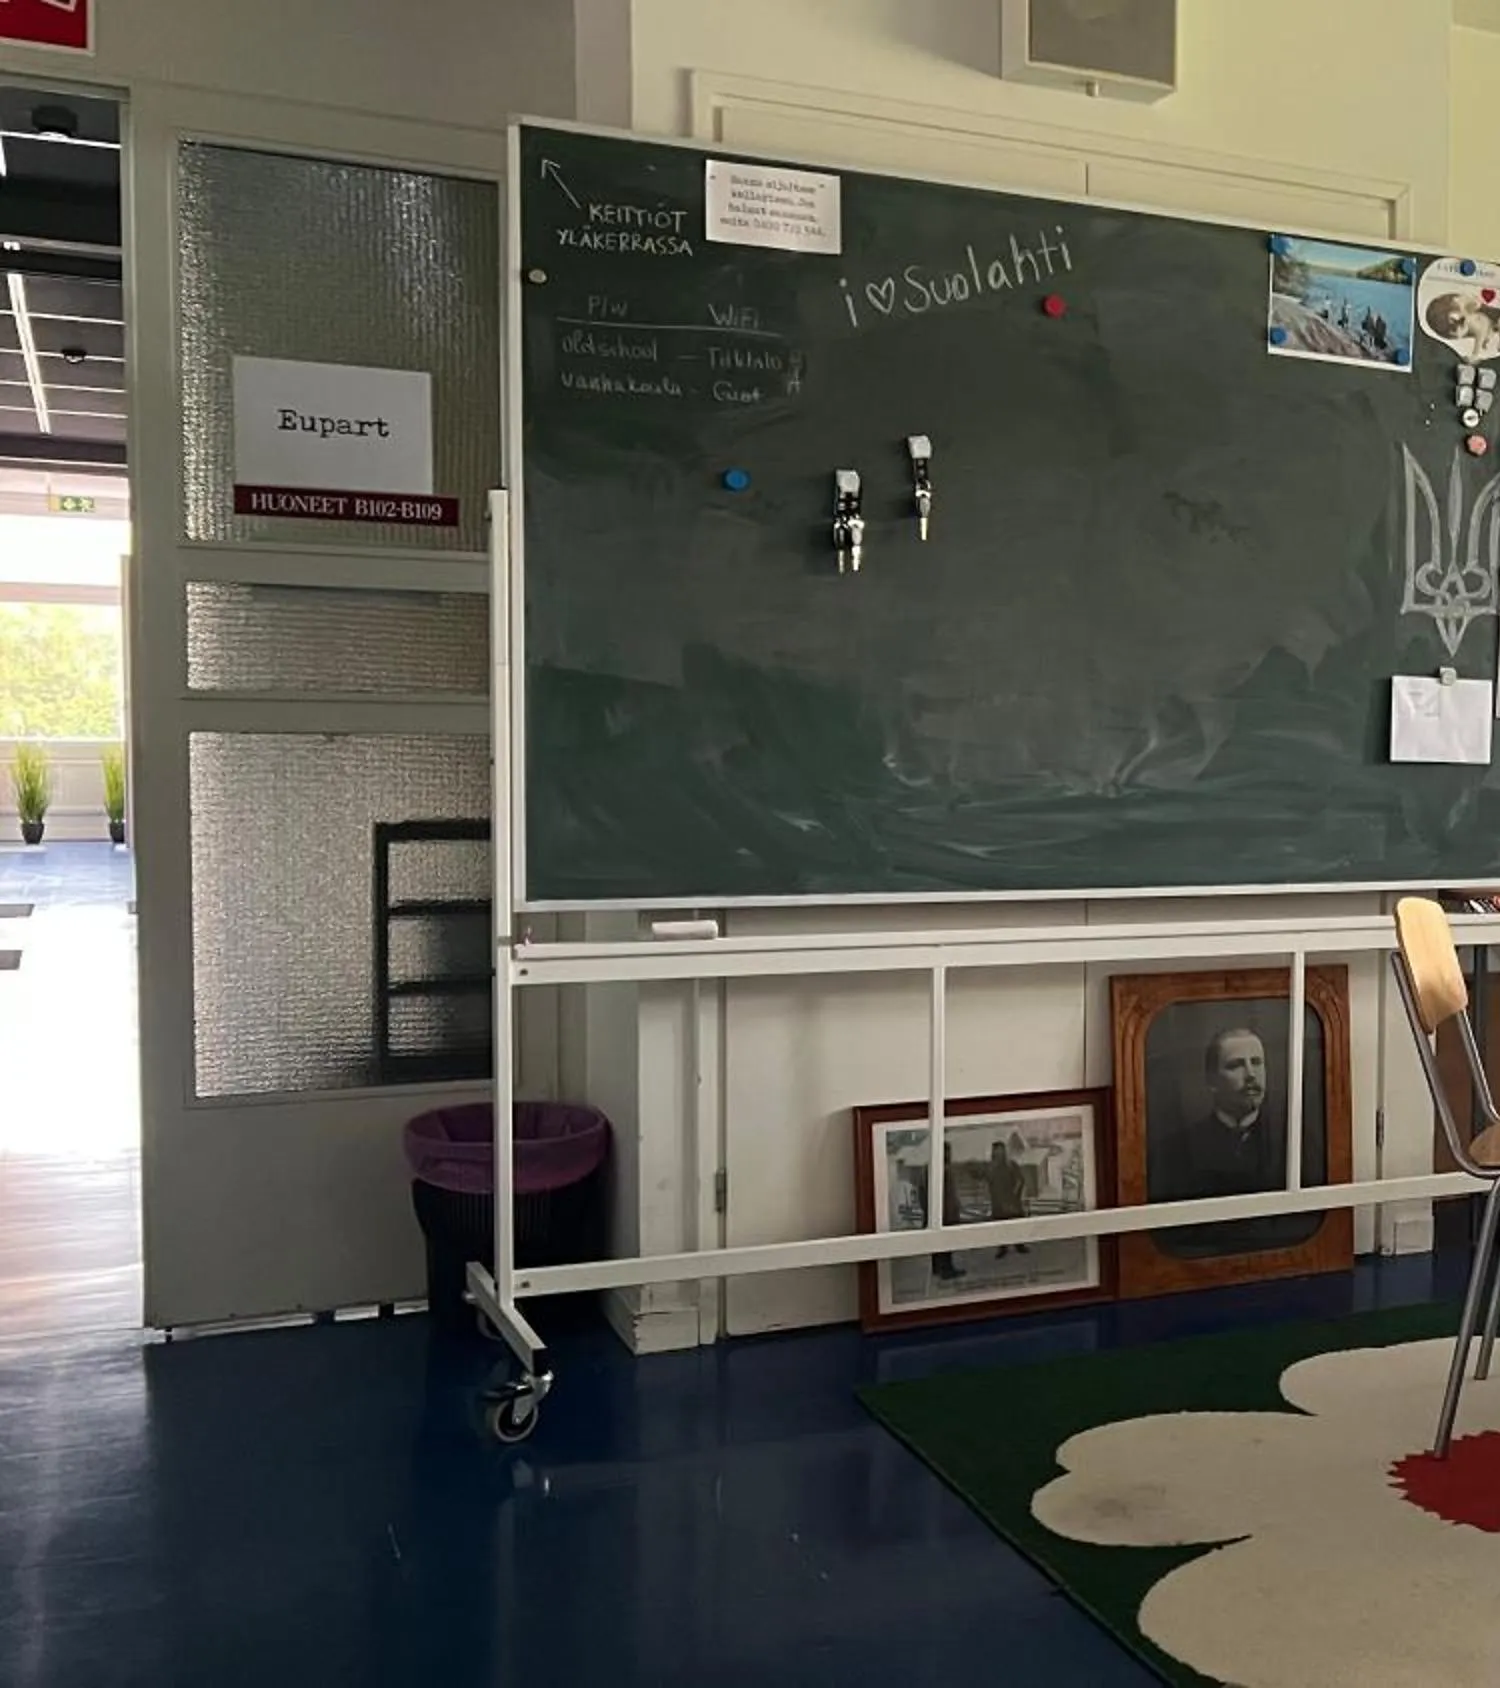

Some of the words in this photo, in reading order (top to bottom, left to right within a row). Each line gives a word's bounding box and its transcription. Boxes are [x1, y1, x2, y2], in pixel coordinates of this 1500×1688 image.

[588, 202, 689, 233] KEITTIÖT
[556, 225, 693, 256] YLÄKERRASSA
[904, 225, 1072, 312] Suolahti
[277, 409, 390, 439] Eupart
[251, 493, 348, 516] HUONEET
[354, 498, 443, 521] B102-B109
